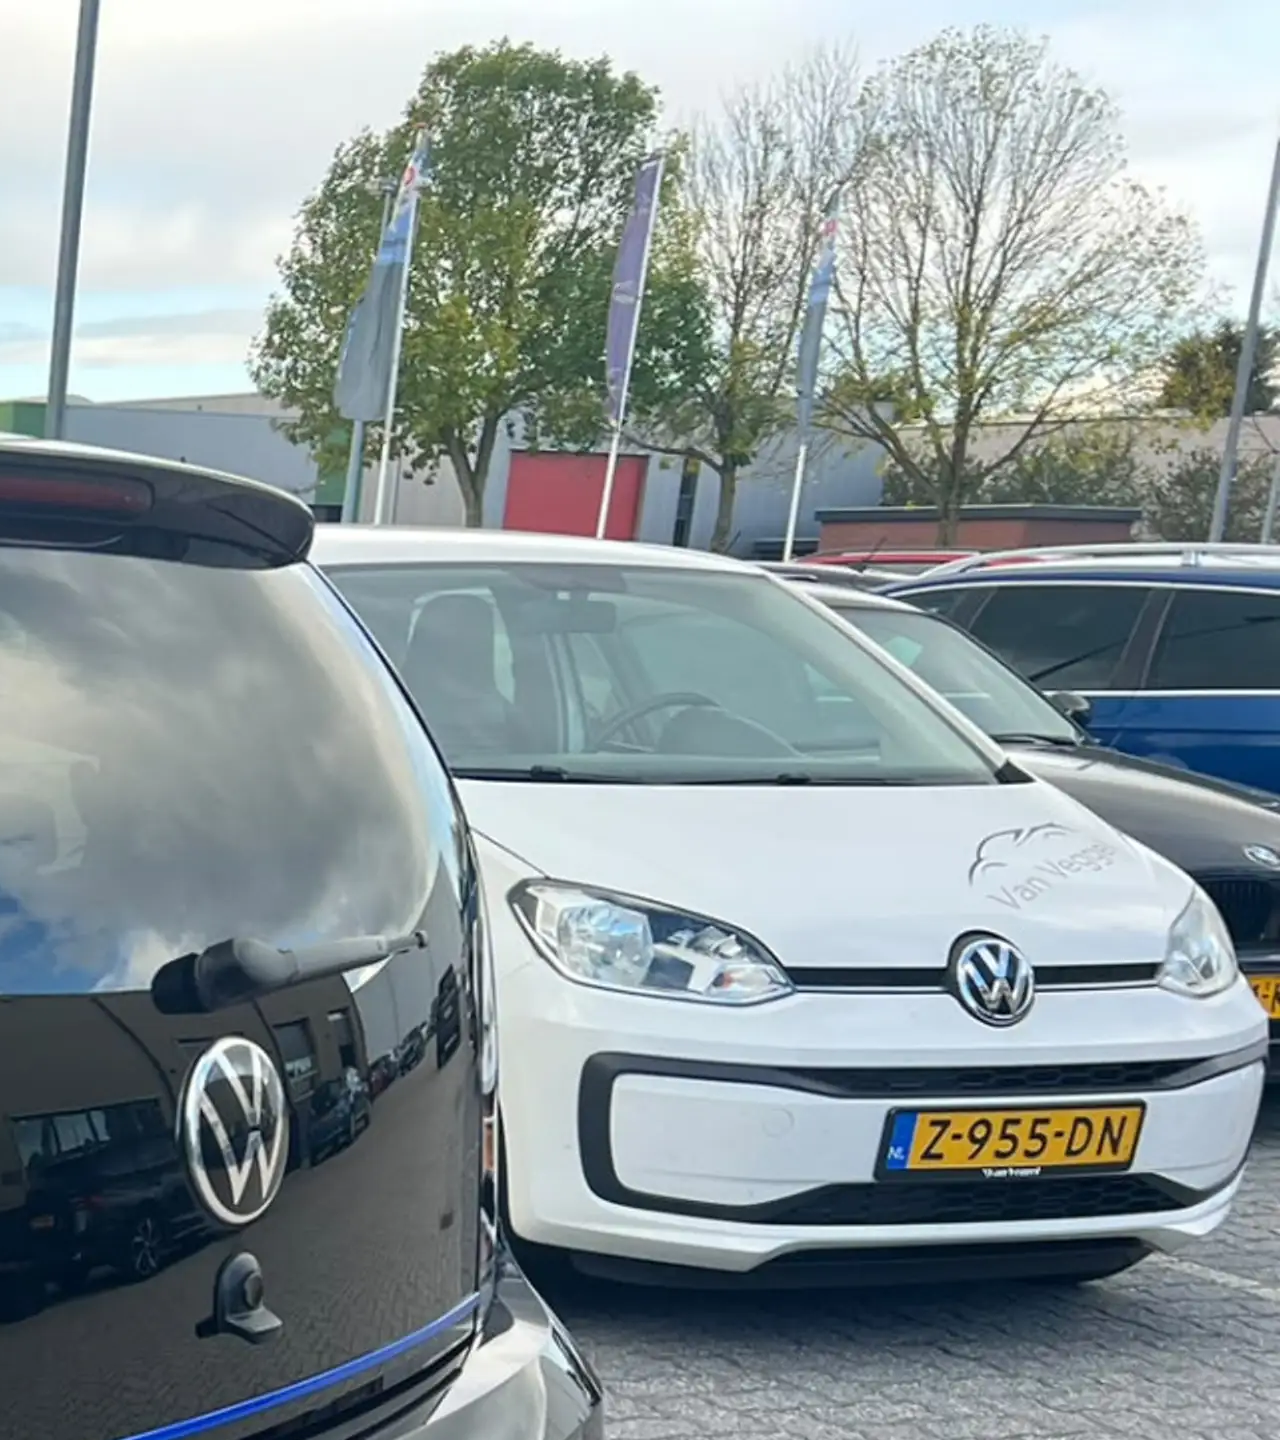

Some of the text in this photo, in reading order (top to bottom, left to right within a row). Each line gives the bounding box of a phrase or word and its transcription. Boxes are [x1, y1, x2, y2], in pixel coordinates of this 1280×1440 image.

[986, 842, 1118, 910] Van Vegge
[920, 1115, 1128, 1161] Z-955-DN
